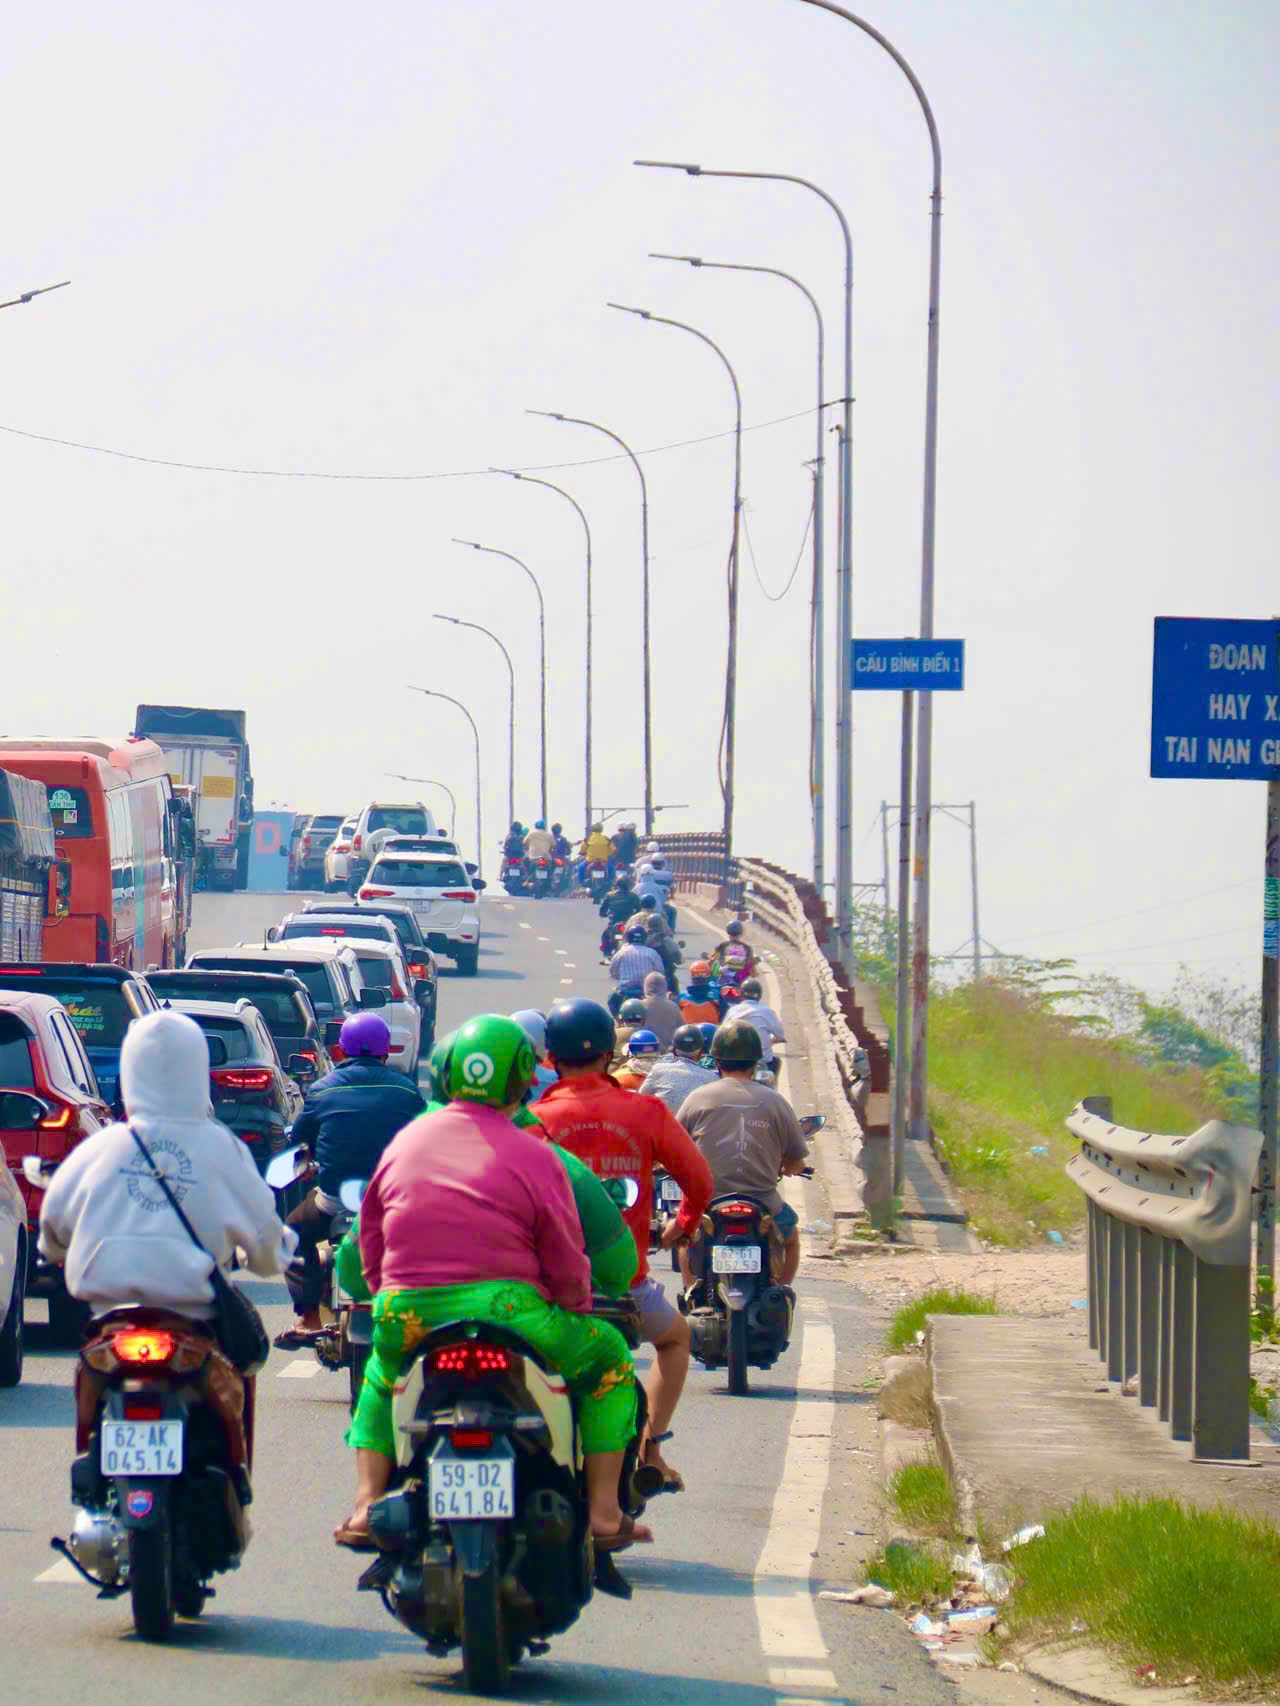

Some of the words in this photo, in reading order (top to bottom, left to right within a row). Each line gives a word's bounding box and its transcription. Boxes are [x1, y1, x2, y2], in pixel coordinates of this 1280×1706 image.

[953, 657, 960, 672] 1
[1209, 643, 1266, 675] ĐOẠN
[1209, 693, 1251, 720] HAY
[1264, 694, 1280, 720] X
[1165, 736, 1198, 763] TAI
[1207, 738, 1251, 770] NẠN
[115, 1425, 168, 1448] 62-AK
[108, 1449, 176, 1473] 045.14
[441, 1463, 501, 1488] 59-D2
[434, 1490, 510, 1515] 641.84
